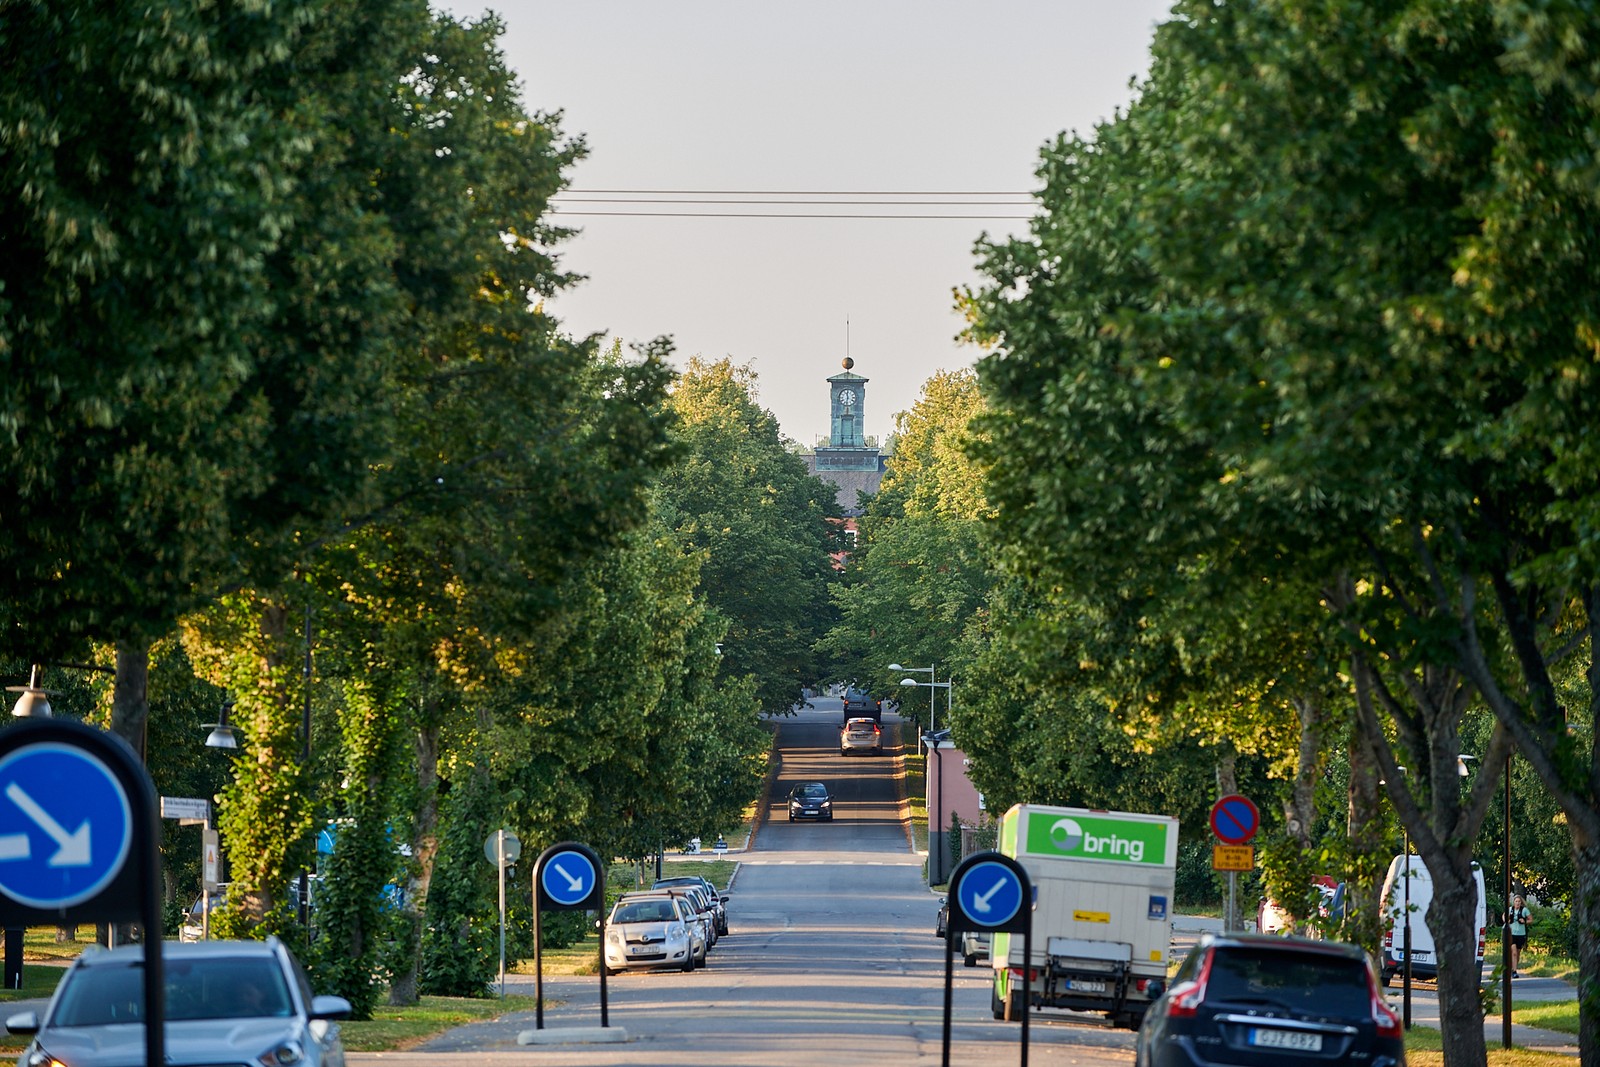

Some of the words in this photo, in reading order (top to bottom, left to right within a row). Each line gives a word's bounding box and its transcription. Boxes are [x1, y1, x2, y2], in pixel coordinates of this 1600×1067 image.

[1084, 832, 1144, 861] bring
[1219, 846, 1248, 855] Torsdag
[1290, 1033, 1317, 1047] 082
